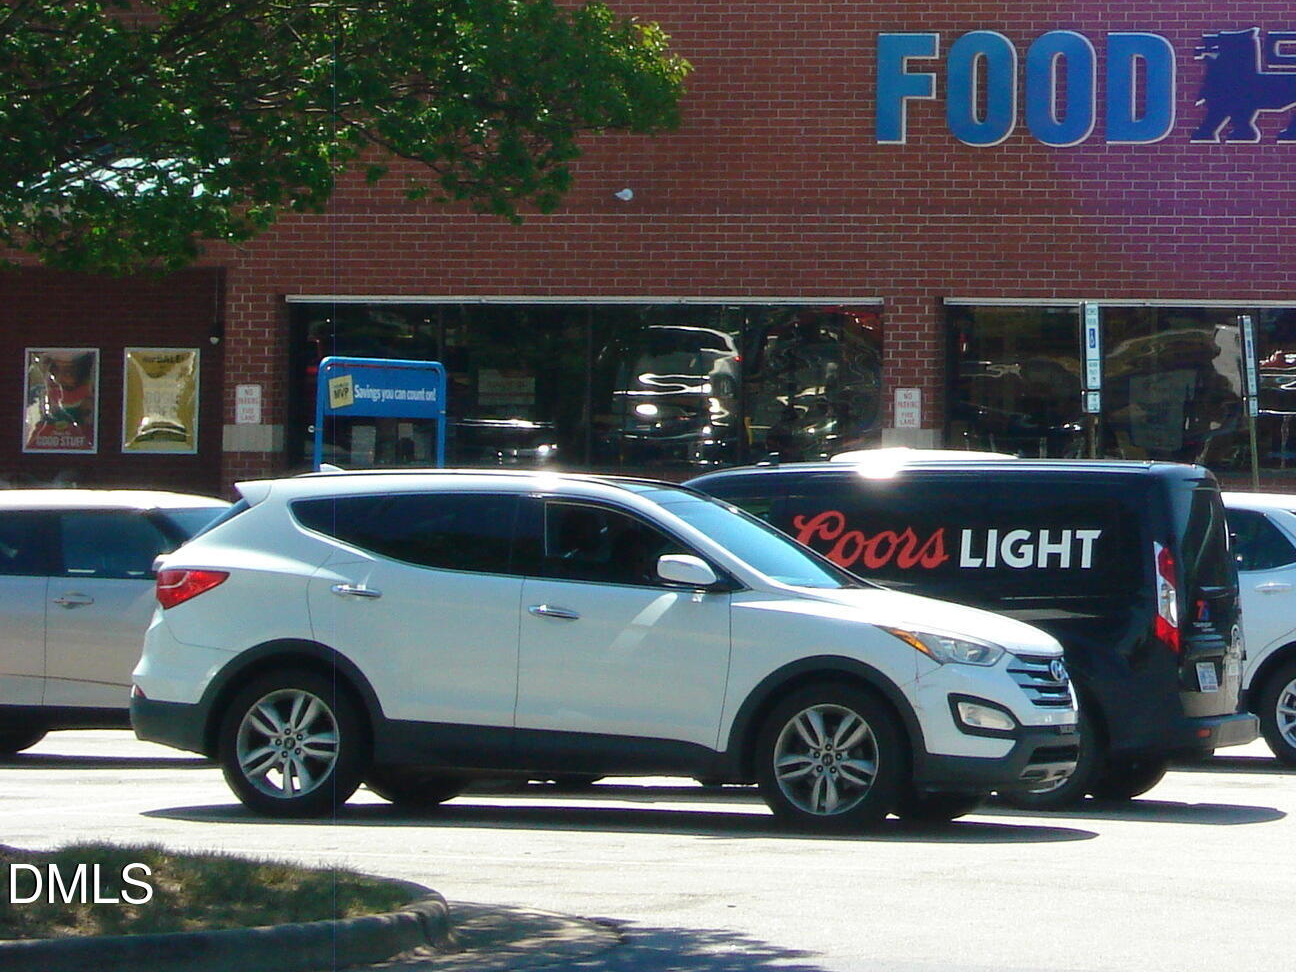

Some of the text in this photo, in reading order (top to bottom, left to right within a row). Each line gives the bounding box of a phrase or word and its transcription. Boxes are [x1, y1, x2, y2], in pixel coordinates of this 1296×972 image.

[876, 30, 1178, 147] FOOD
[333, 387, 350, 400] MVP
[354, 384, 380, 402] Savings
[380, 388, 394, 403] you
[394, 389, 406, 400] can
[407, 388, 425, 401] count
[793, 510, 1102, 569] Coors LIGHT
